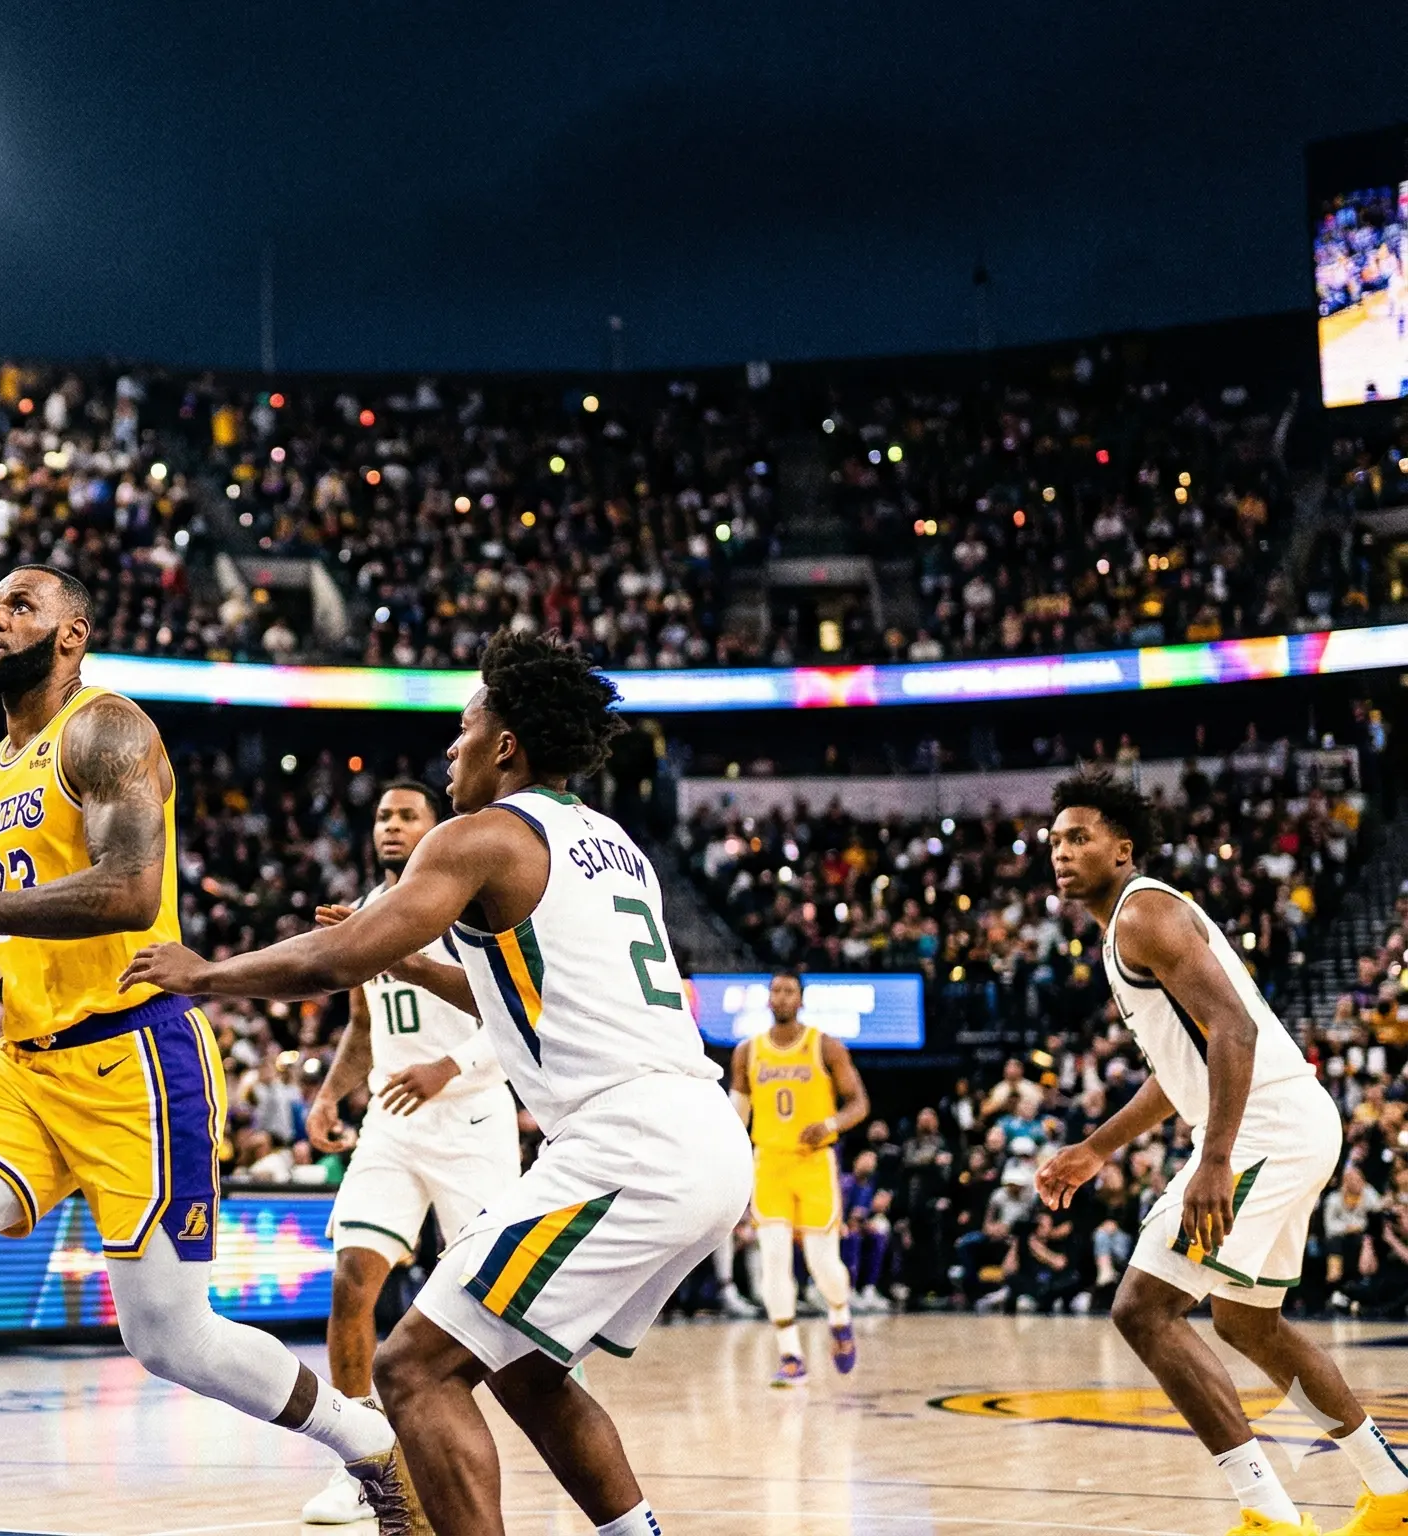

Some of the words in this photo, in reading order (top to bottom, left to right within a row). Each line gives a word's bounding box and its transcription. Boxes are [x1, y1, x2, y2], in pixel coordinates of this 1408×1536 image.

[568, 837, 648, 888] SEXTON
[612, 895, 684, 1011] 2
[381, 988, 421, 1035] 10
[775, 1086, 794, 1121] 0
